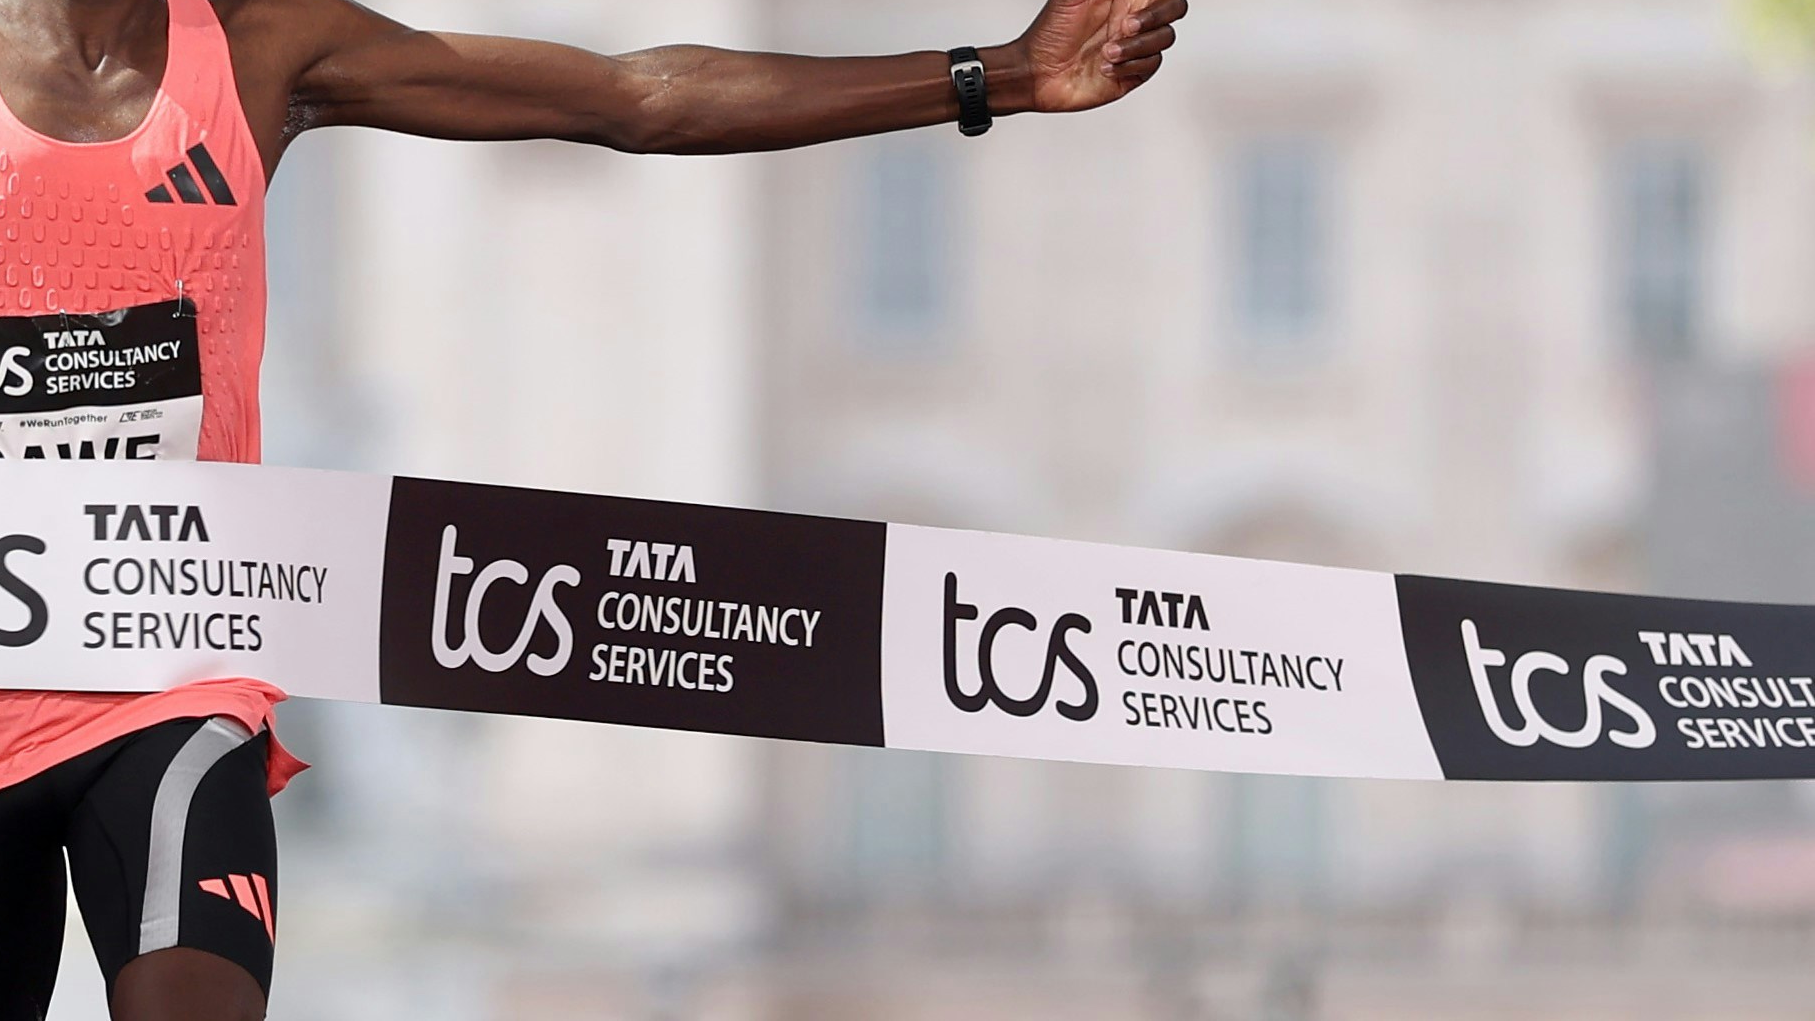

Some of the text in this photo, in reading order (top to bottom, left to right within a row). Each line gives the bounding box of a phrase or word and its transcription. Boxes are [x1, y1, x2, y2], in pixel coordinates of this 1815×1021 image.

[43, 330, 106, 349] TATA
[44, 340, 181, 371] CONSULTANCY
[45, 370, 136, 394] SERVICES
[19, 413, 108, 429] #WeRunTogether
[84, 504, 210, 543] TATA
[84, 557, 328, 604] CONSULTANCY
[606, 538, 697, 583] TATA
[431, 524, 582, 677] tcs
[596, 590, 822, 648] CONSULTANCY
[1115, 587, 1211, 631] TATA
[83, 611, 263, 652] SERVICES
[943, 571, 1099, 722] tcs
[1638, 631, 1754, 667] TATA
[588, 643, 735, 693] SERVICES
[1117, 639, 1345, 692] CONSULTANCY
[1460, 619, 1658, 749] tcs
[1122, 690, 1273, 735] SERVICES
[1658, 676, 1815, 708] CONSULT
